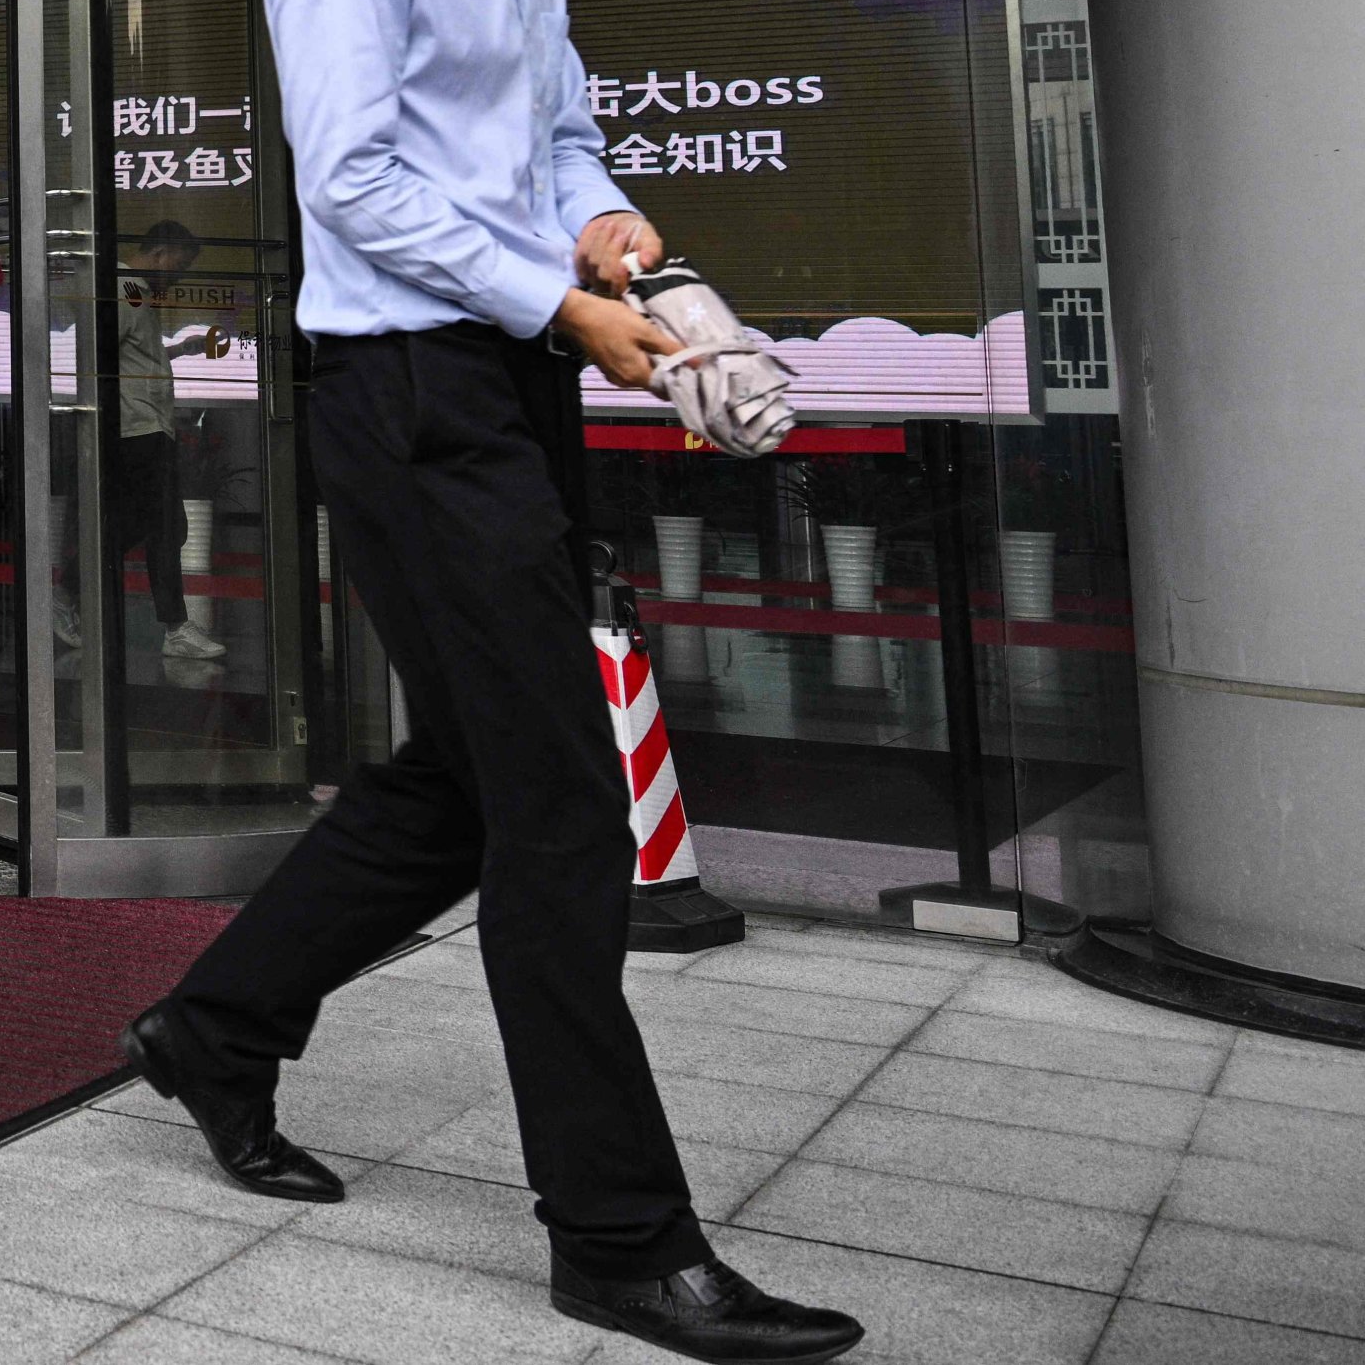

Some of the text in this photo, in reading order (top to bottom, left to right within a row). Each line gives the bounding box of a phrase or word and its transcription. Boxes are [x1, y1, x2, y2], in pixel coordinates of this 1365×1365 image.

[56, 96, 251, 137] 我们一
[598, 130, 788, 176] 全知识
[174, 287, 235, 305] PUSH
